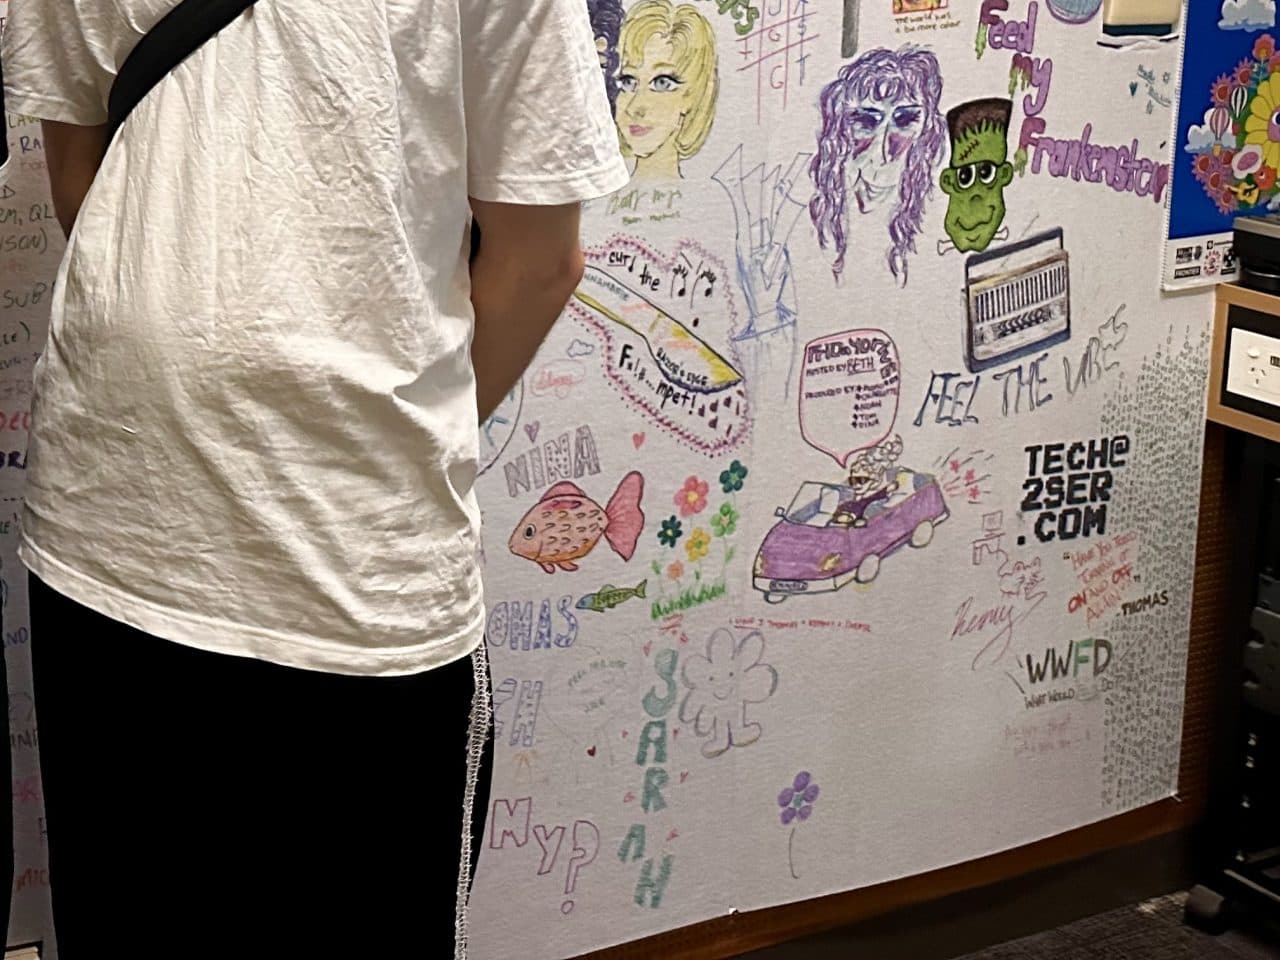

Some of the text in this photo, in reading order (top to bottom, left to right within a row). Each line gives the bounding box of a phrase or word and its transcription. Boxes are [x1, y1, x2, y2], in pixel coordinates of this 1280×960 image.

[914, 353, 1053, 427] FEEL THE
[503, 425, 601, 498] NINA
[1023, 435, 1130, 477] TECH@
[1020, 470, 1114, 511] 2SER
[1017, 504, 1107, 545] .COM
[1026, 638, 1113, 683] WWFD
[618, 647, 679, 908] SARAH
